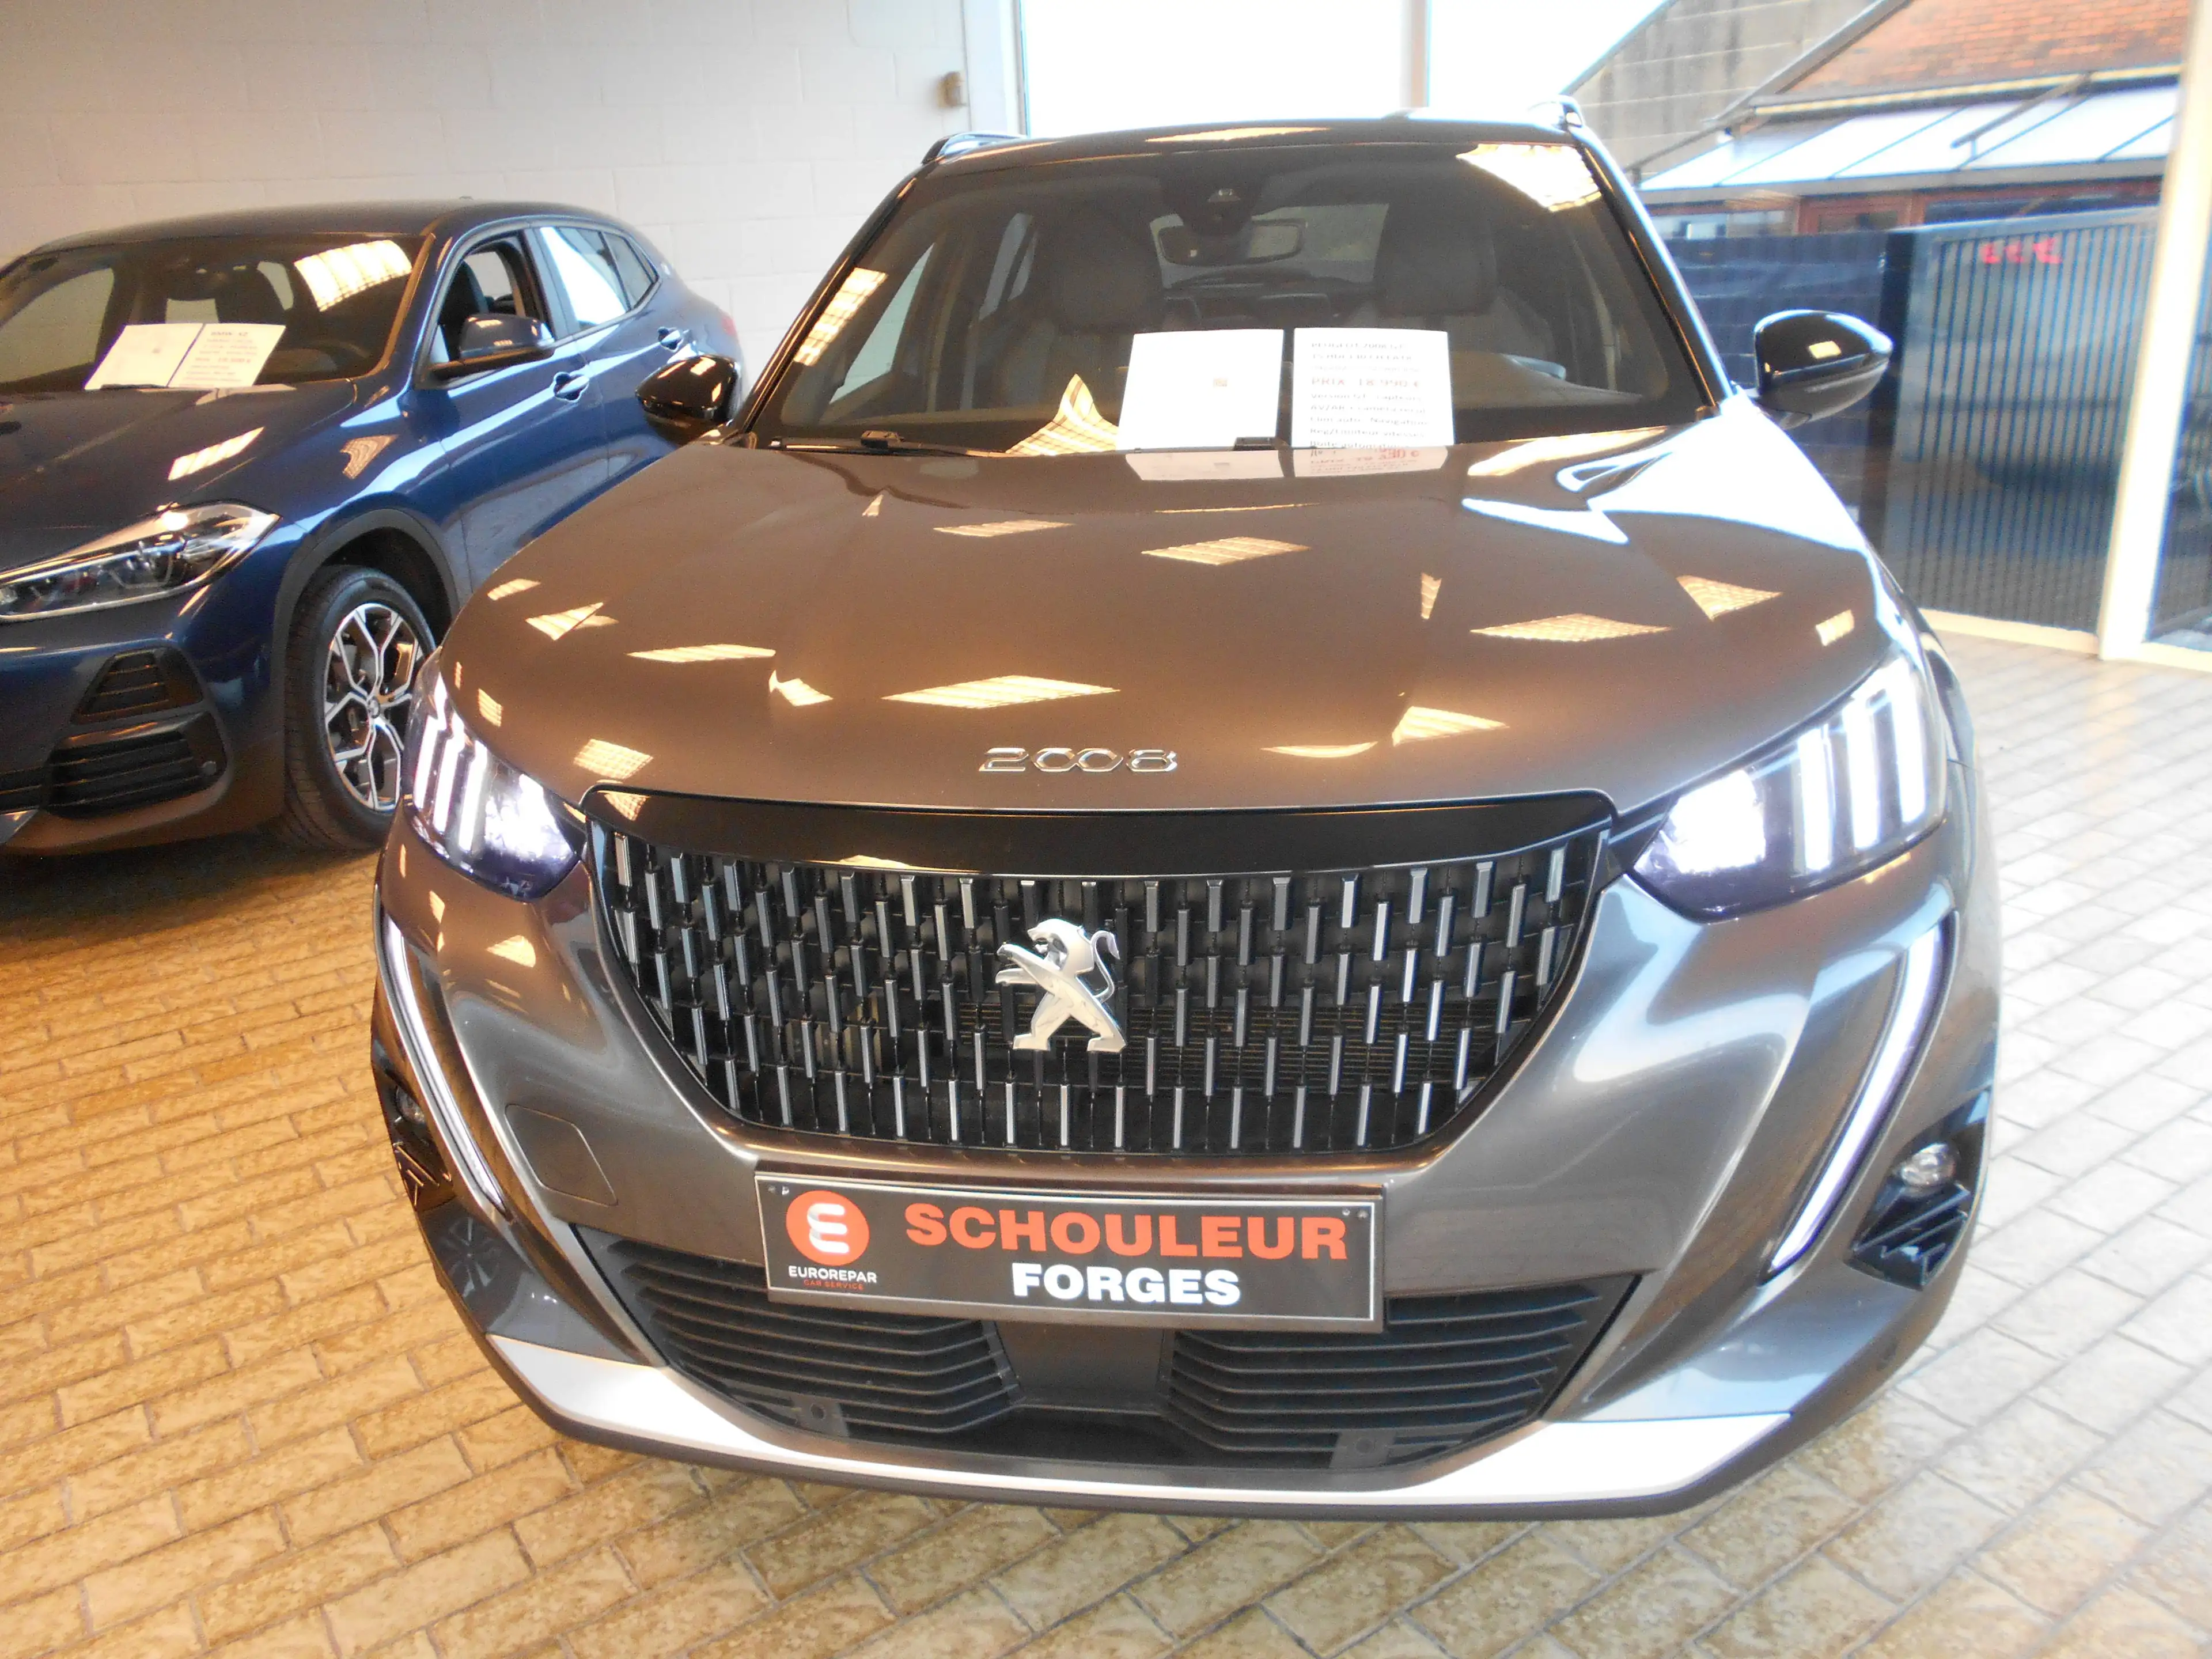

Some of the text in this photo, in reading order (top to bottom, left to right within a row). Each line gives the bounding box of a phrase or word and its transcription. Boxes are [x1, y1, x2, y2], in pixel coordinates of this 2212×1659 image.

[1311, 377, 1346, 387] PRIX
[1358, 378, 1374, 387] 18
[979, 747, 1178, 772] 2008
[904, 1203, 1347, 1260] SCHOULEUR
[788, 1266, 877, 1283] EUROREPAR
[1011, 1262, 1241, 1305] FORGES
[824, 1282, 865, 1291] SERVICE
